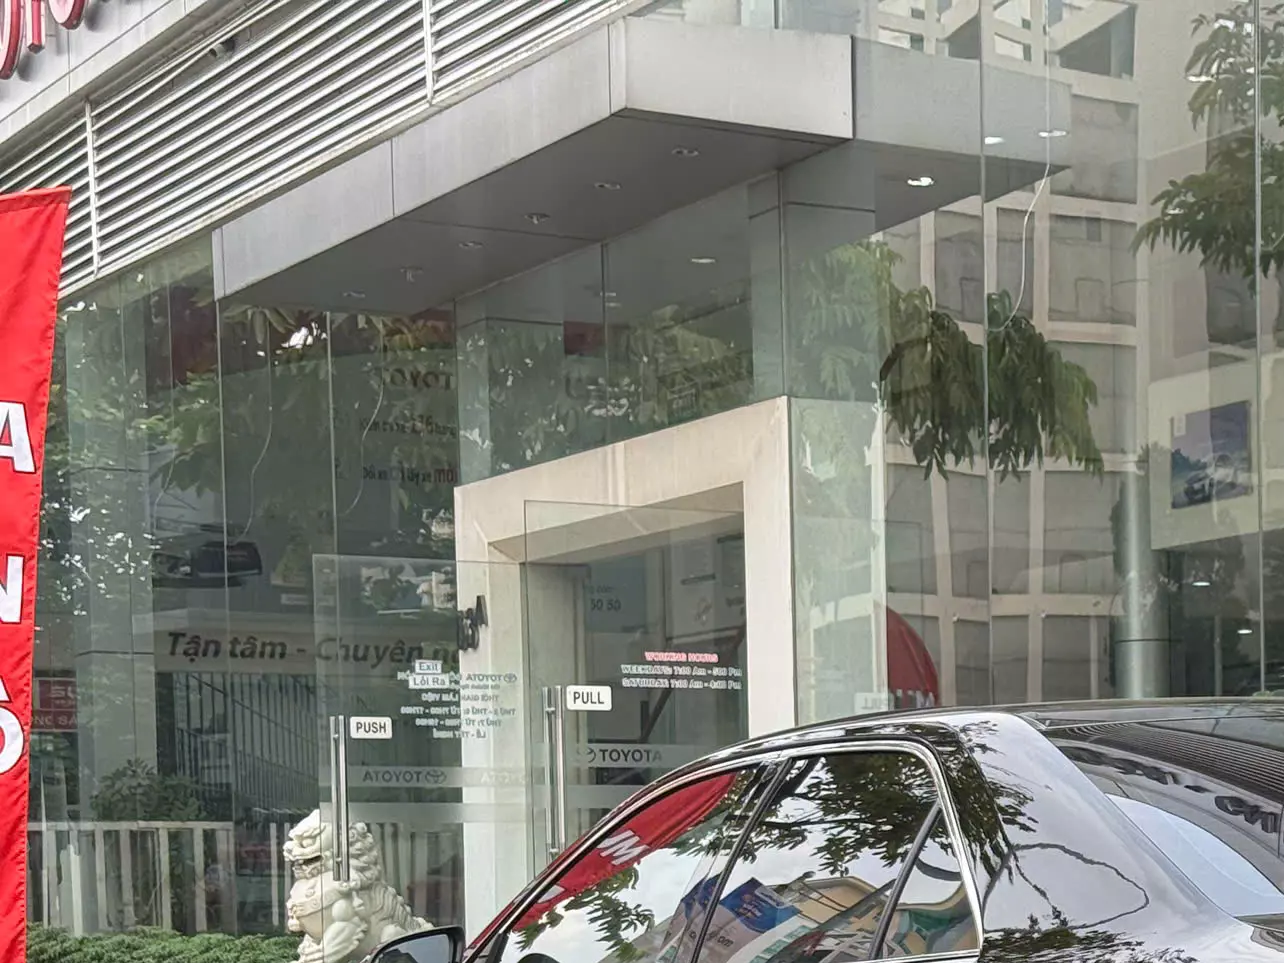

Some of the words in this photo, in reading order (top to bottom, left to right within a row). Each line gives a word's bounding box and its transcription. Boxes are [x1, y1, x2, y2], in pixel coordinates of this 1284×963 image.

[167, 632, 222, 663] Tận
[228, 633, 287, 660] tâm
[315, 636, 423, 669] Chuyên
[419, 661, 439, 672] Exit
[572, 691, 605, 705] PULL
[355, 721, 387, 734] PUSH
[600, 749, 663, 763] TOYOTA
